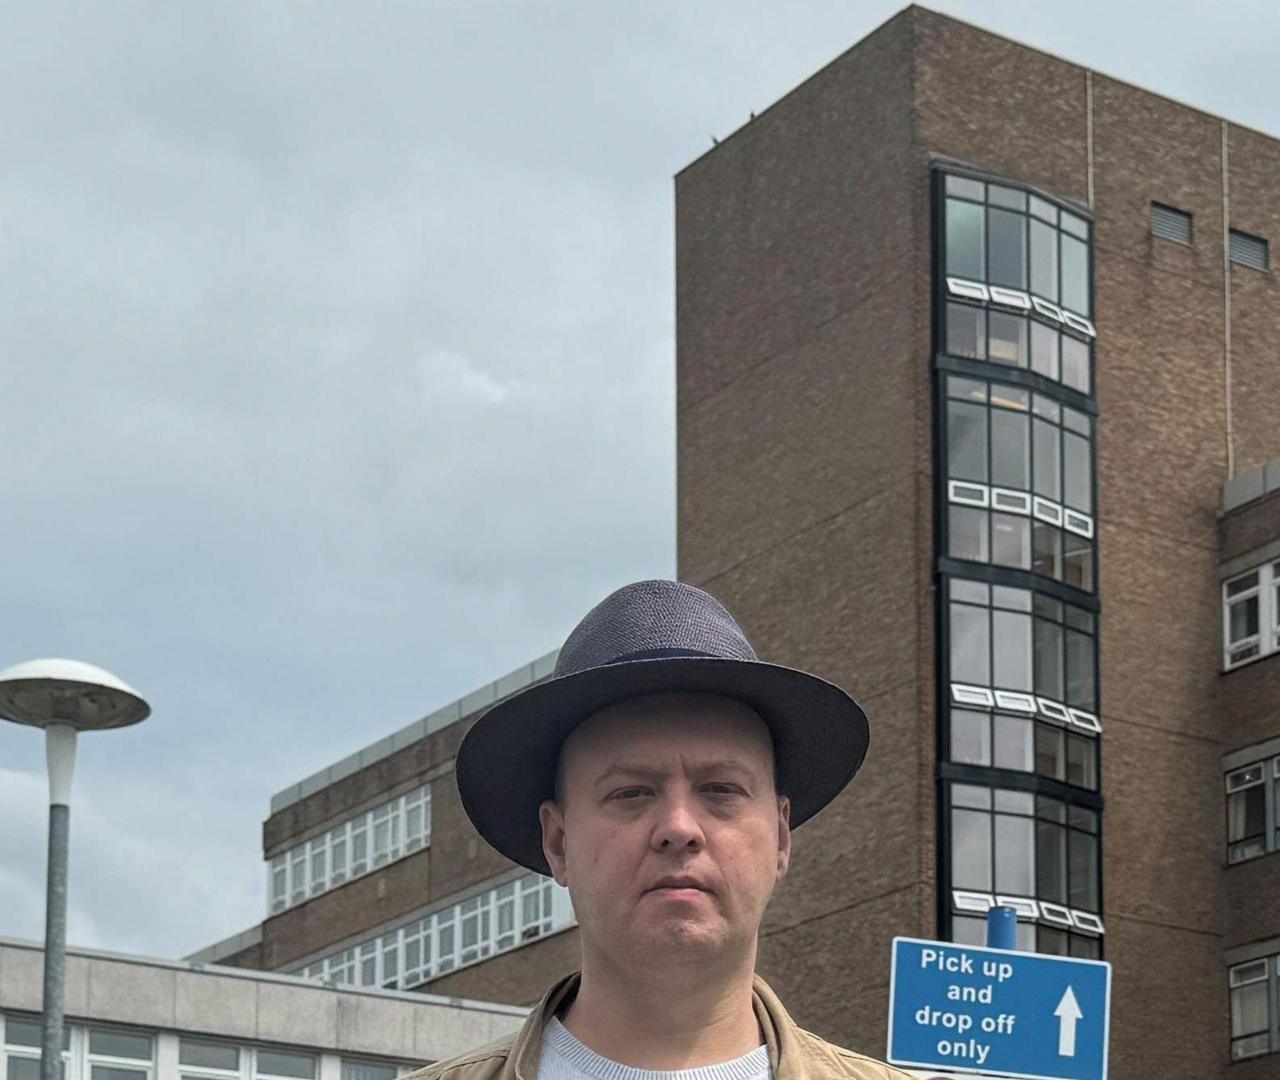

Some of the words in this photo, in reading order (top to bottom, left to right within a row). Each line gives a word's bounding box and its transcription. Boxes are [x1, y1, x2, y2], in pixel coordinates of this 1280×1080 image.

[921, 948, 973, 974] Pick
[983, 962, 1013, 981] up
[947, 984, 993, 1004] and
[915, 1006, 973, 1034] drop
[981, 1014, 1016, 1034] off
[937, 1038, 990, 1065] only
